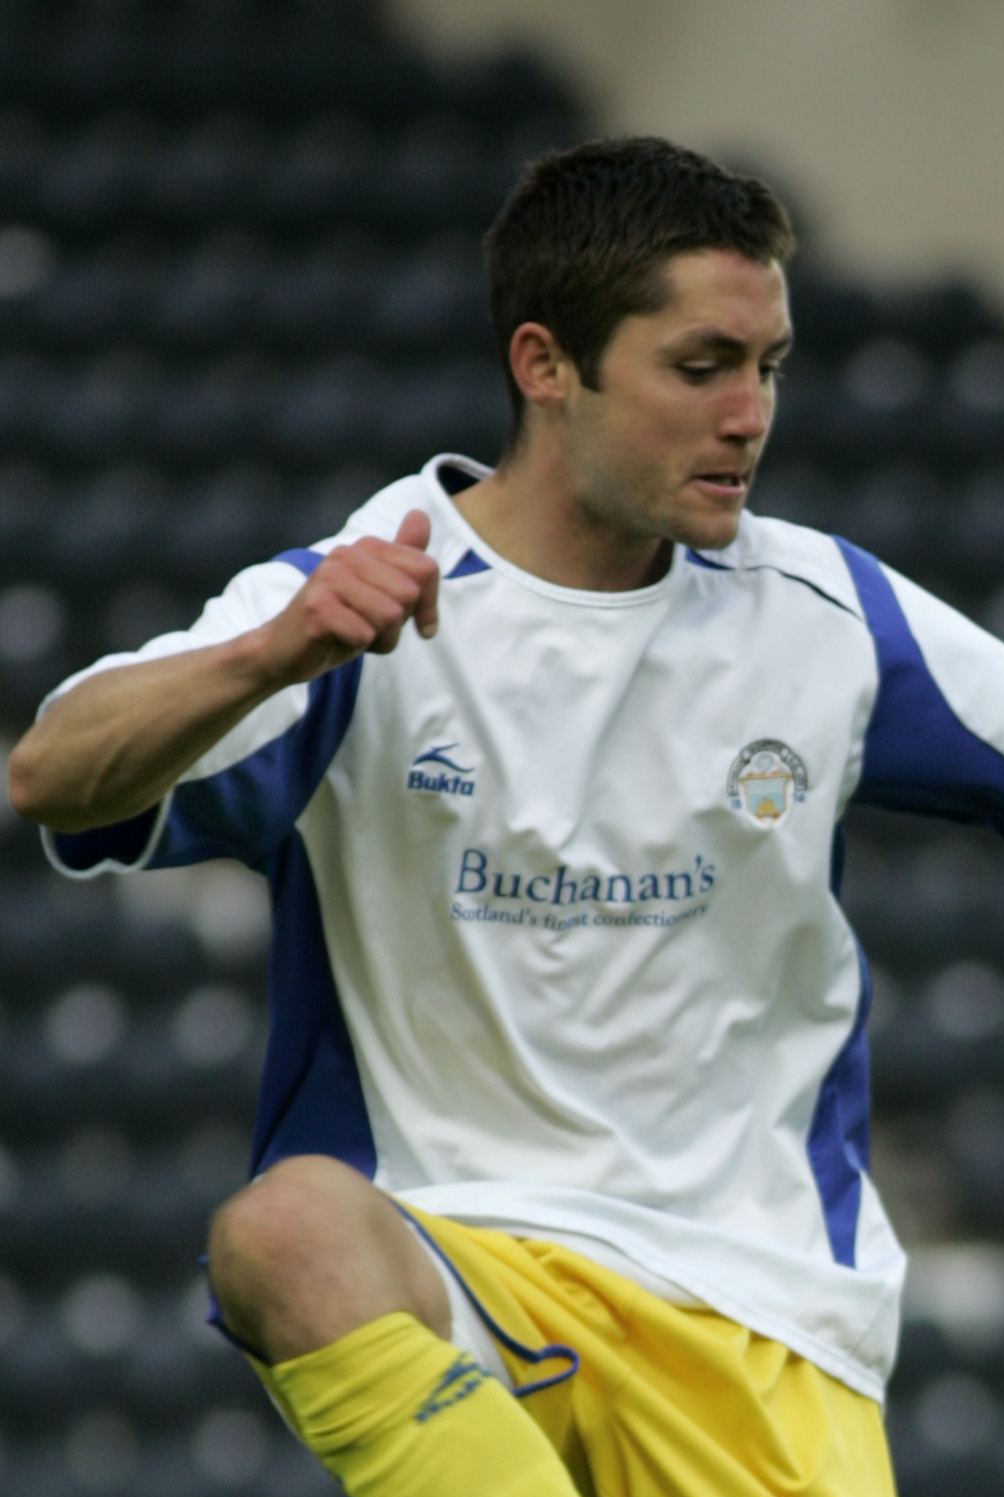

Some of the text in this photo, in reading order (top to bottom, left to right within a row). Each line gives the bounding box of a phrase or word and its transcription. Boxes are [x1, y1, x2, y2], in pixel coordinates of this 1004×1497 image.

[407, 771, 475, 796] Bukta
[455, 848, 716, 906] Buchanan's
[451, 902, 538, 927] Scotland's
